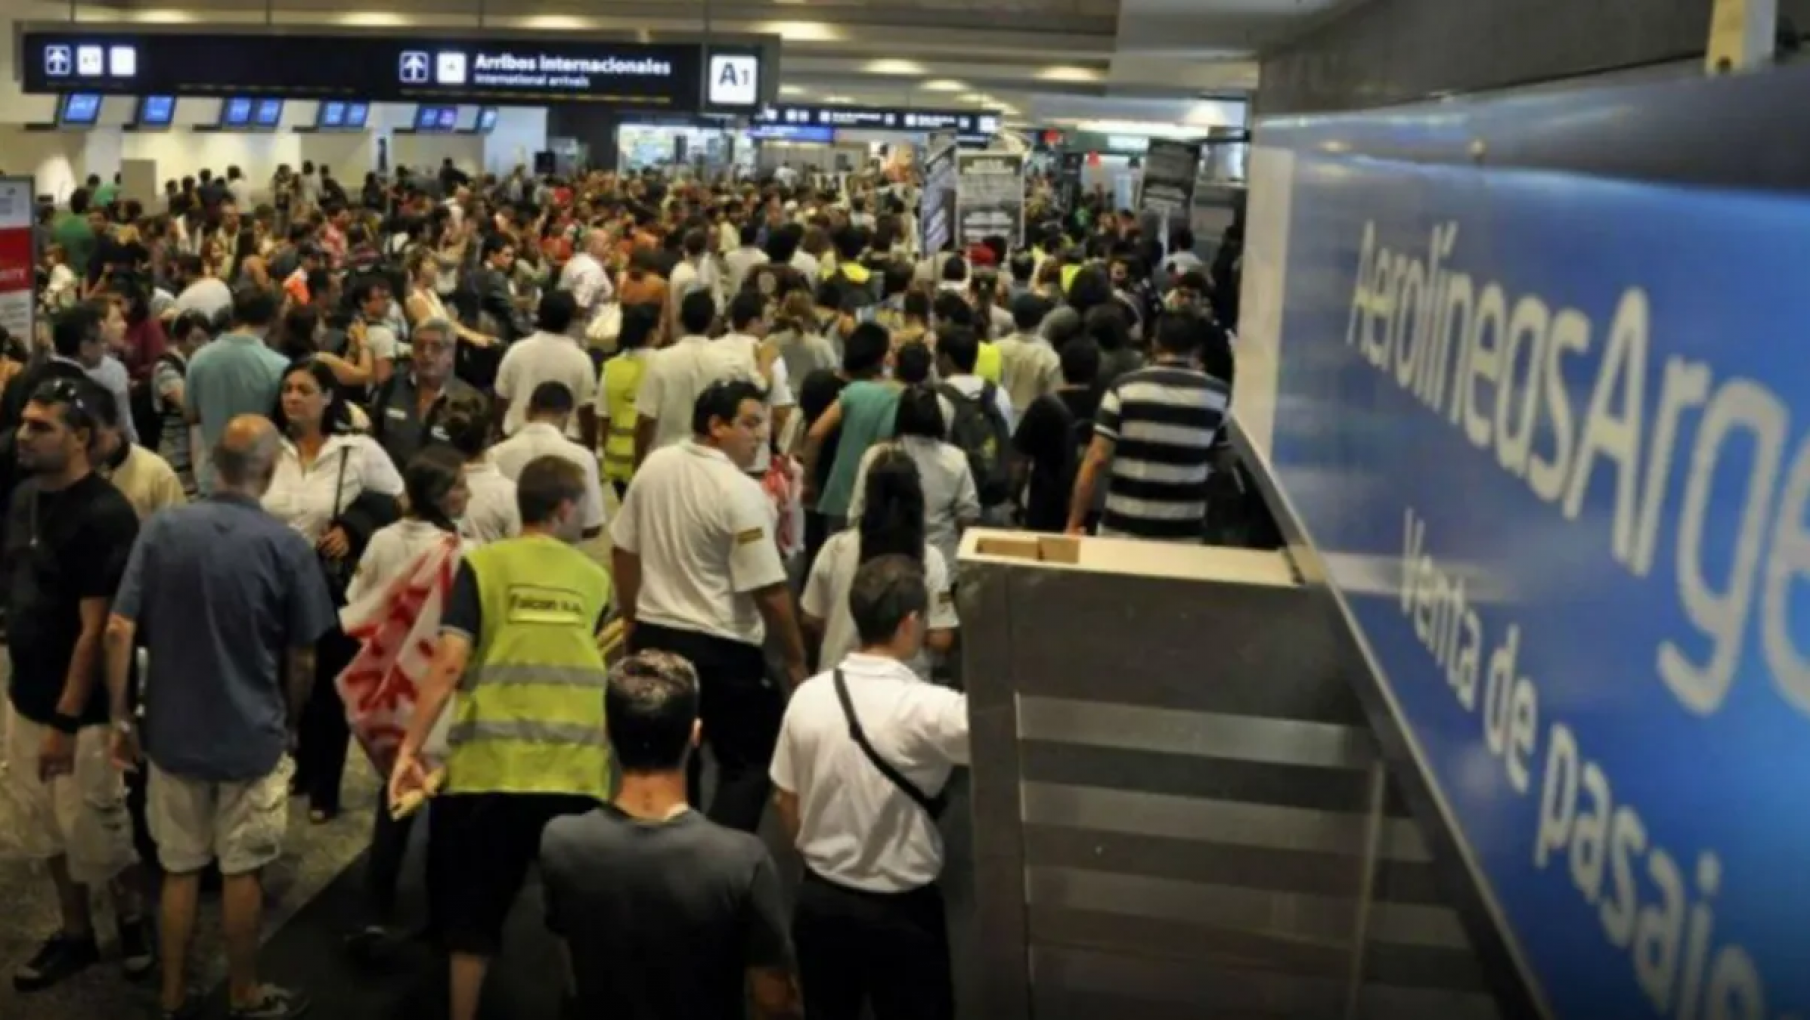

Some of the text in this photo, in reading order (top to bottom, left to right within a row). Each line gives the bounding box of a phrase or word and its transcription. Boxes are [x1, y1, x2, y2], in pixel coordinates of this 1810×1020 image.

[475, 53, 536, 71] Arribos
[1402, 507, 1770, 1020] Venta de pasaj
